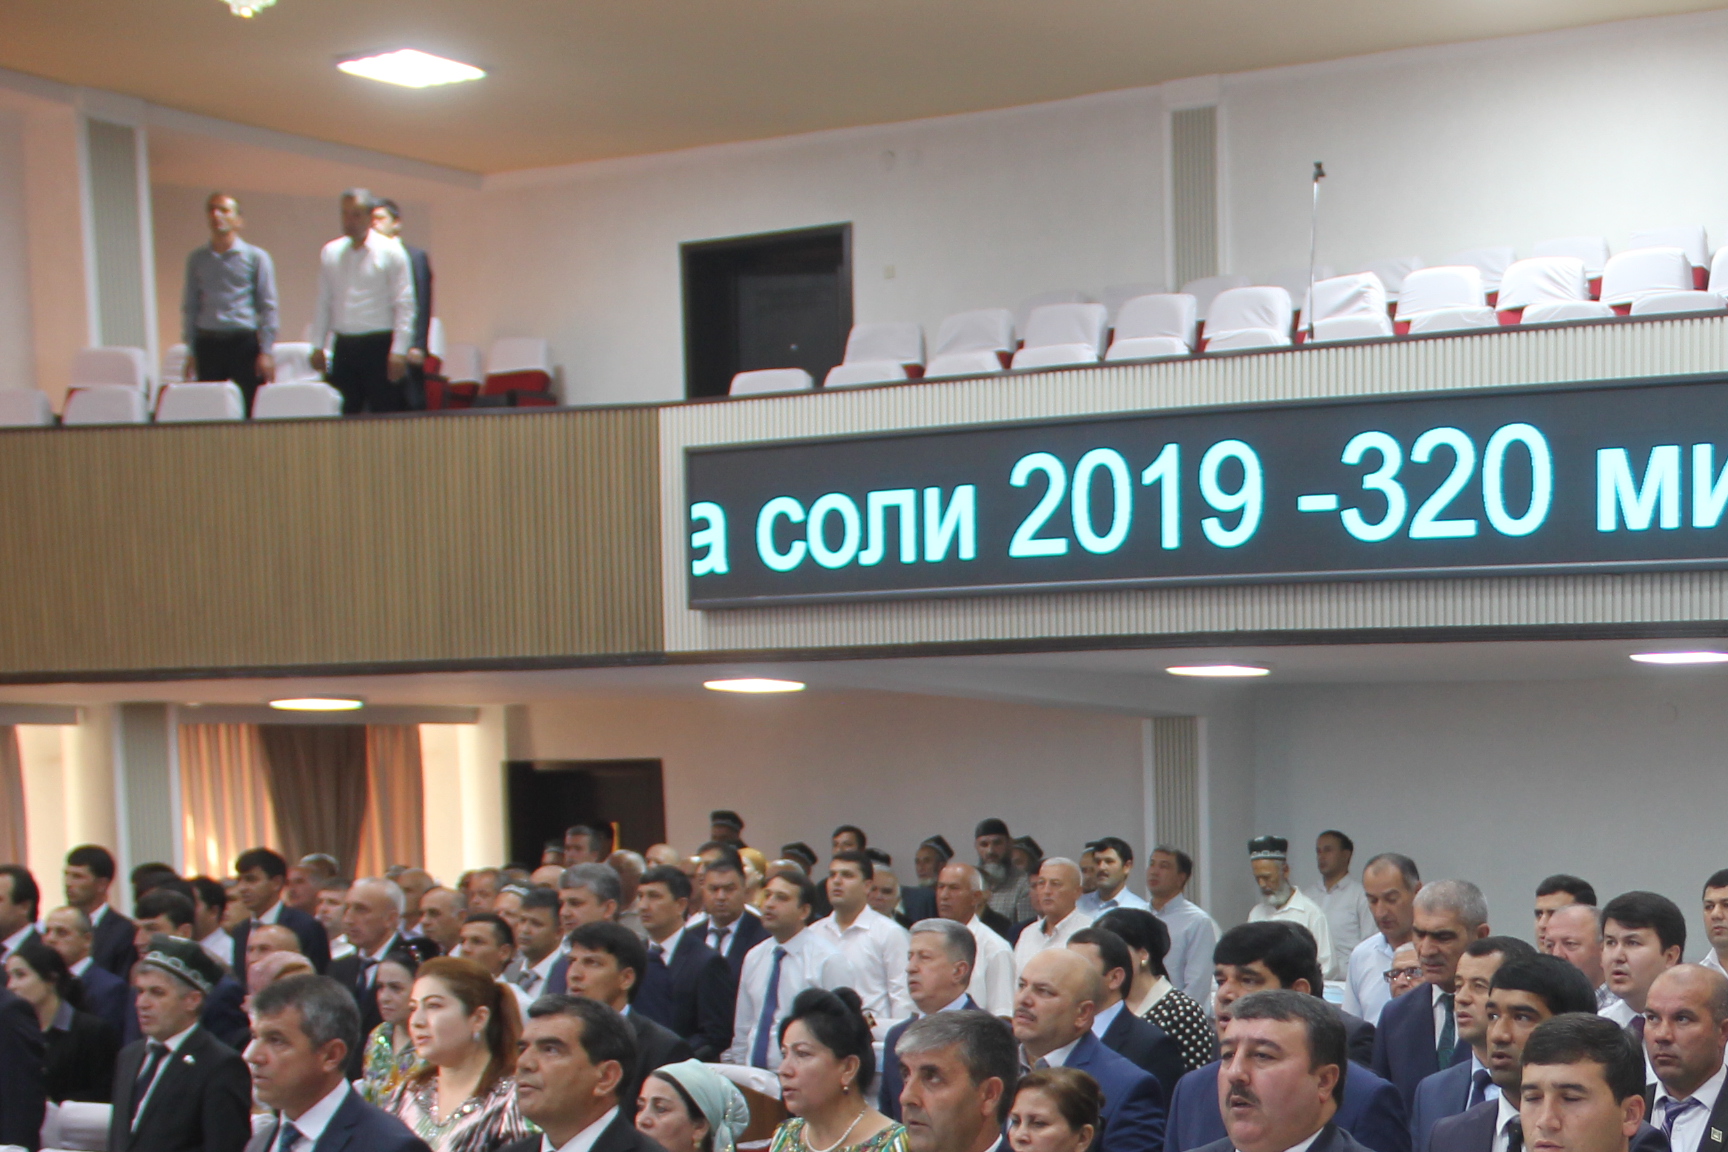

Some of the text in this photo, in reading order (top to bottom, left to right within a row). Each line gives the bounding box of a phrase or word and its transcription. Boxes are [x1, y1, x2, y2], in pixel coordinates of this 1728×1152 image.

[756, 483, 978, 573] соли
[1008, 439, 1266, 558] 2019
[1297, 422, 1556, 544] -320
